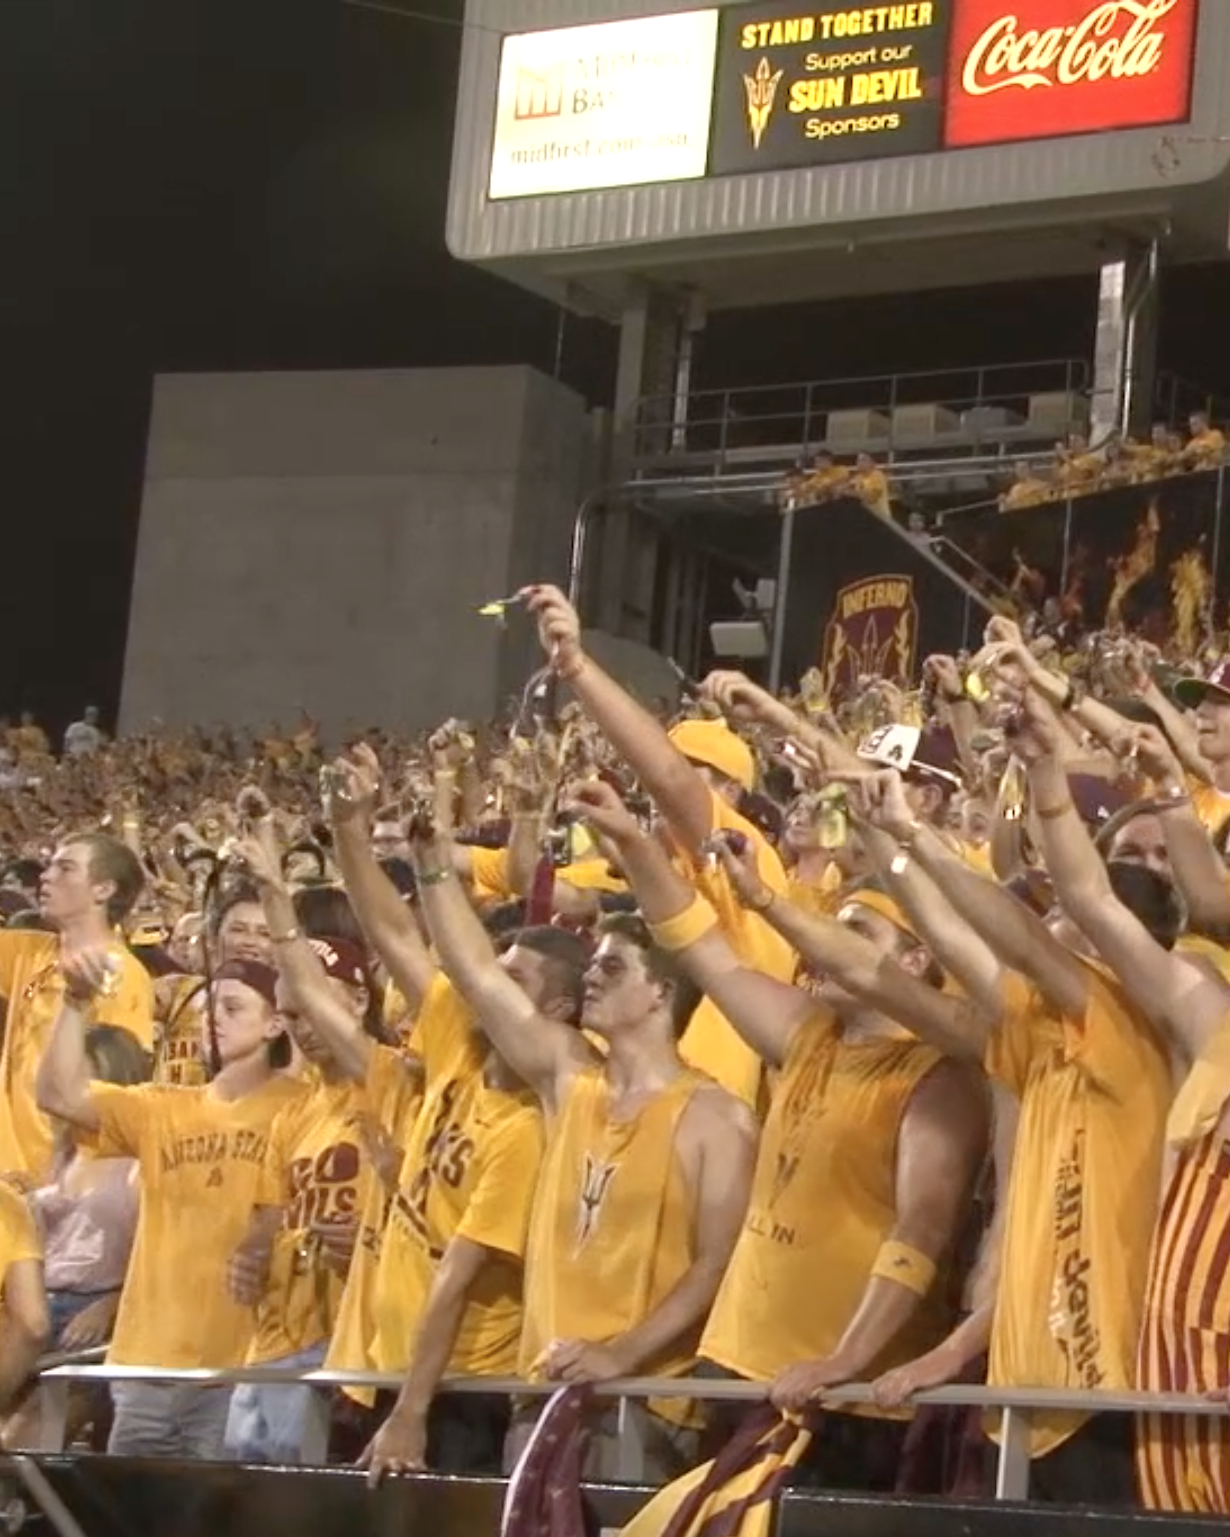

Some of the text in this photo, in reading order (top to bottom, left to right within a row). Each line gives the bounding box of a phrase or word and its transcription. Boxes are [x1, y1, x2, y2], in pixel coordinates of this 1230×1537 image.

[742, 2, 932, 48] STAND TOGETHER
[962, 0, 1177, 95] Coca-Cola
[805, 45, 912, 71] Support our
[789, 67, 921, 113] SUN DEVIL
[805, 114, 899, 139] Sponsors
